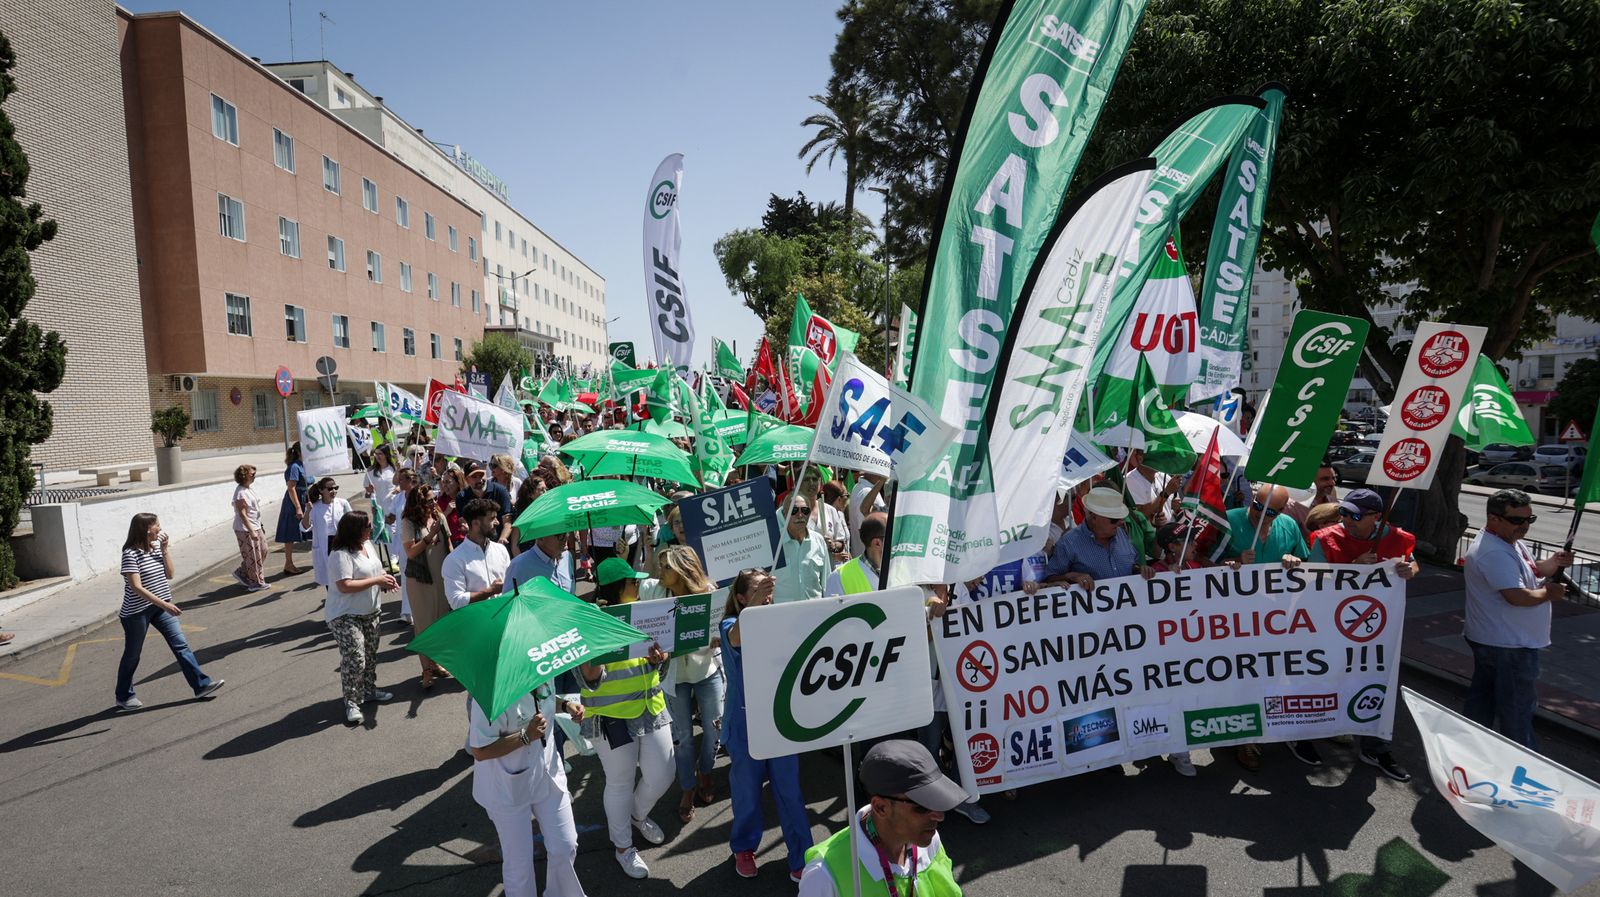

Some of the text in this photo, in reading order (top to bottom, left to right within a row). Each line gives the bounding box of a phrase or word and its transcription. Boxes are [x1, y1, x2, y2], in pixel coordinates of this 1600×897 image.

[1040, 14, 1100, 64] SATSE
[465, 153, 511, 201] HOSPITAL
[655, 192, 676, 206] CSIF
[1212, 160, 1257, 325] SATSE
[941, 73, 1068, 445] SATSE
[652, 247, 689, 343] CSIF
[1130, 312, 1196, 354] UGT
[1200, 326, 1240, 346] CÁDIZ
[1433, 335, 1464, 349] UGT
[1305, 334, 1356, 357] CSIF
[1415, 390, 1444, 405] UGT
[1266, 377, 1325, 477] CSIF
[606, 445, 648, 453] Cádiz
[607, 439, 650, 447] SATSE
[1396, 442, 1425, 456] UGT
[862, 455, 871, 463] DE
[567, 491, 616, 505] SATSE
[568, 499, 618, 511] Cádiz
[933, 536, 945, 546] de
[931, 547, 960, 564] Cádiz
[680, 604, 706, 615] SATSE
[943, 567, 1392, 638] EN DEFENSA DE NUESTRA
[680, 629, 705, 641] SATSE
[1003, 608, 1317, 674] SANIDAD PÚBLICA
[527, 628, 583, 662] SATSE
[536, 644, 591, 676] Cádiz
[1003, 685, 1049, 720] NO
[1057, 664, 1132, 707] MÁS
[1143, 649, 1329, 691] RECORTES
[1287, 697, 1335, 710] CCOO
[1191, 713, 1256, 738] SATSE
[970, 740, 992, 752] UGT
